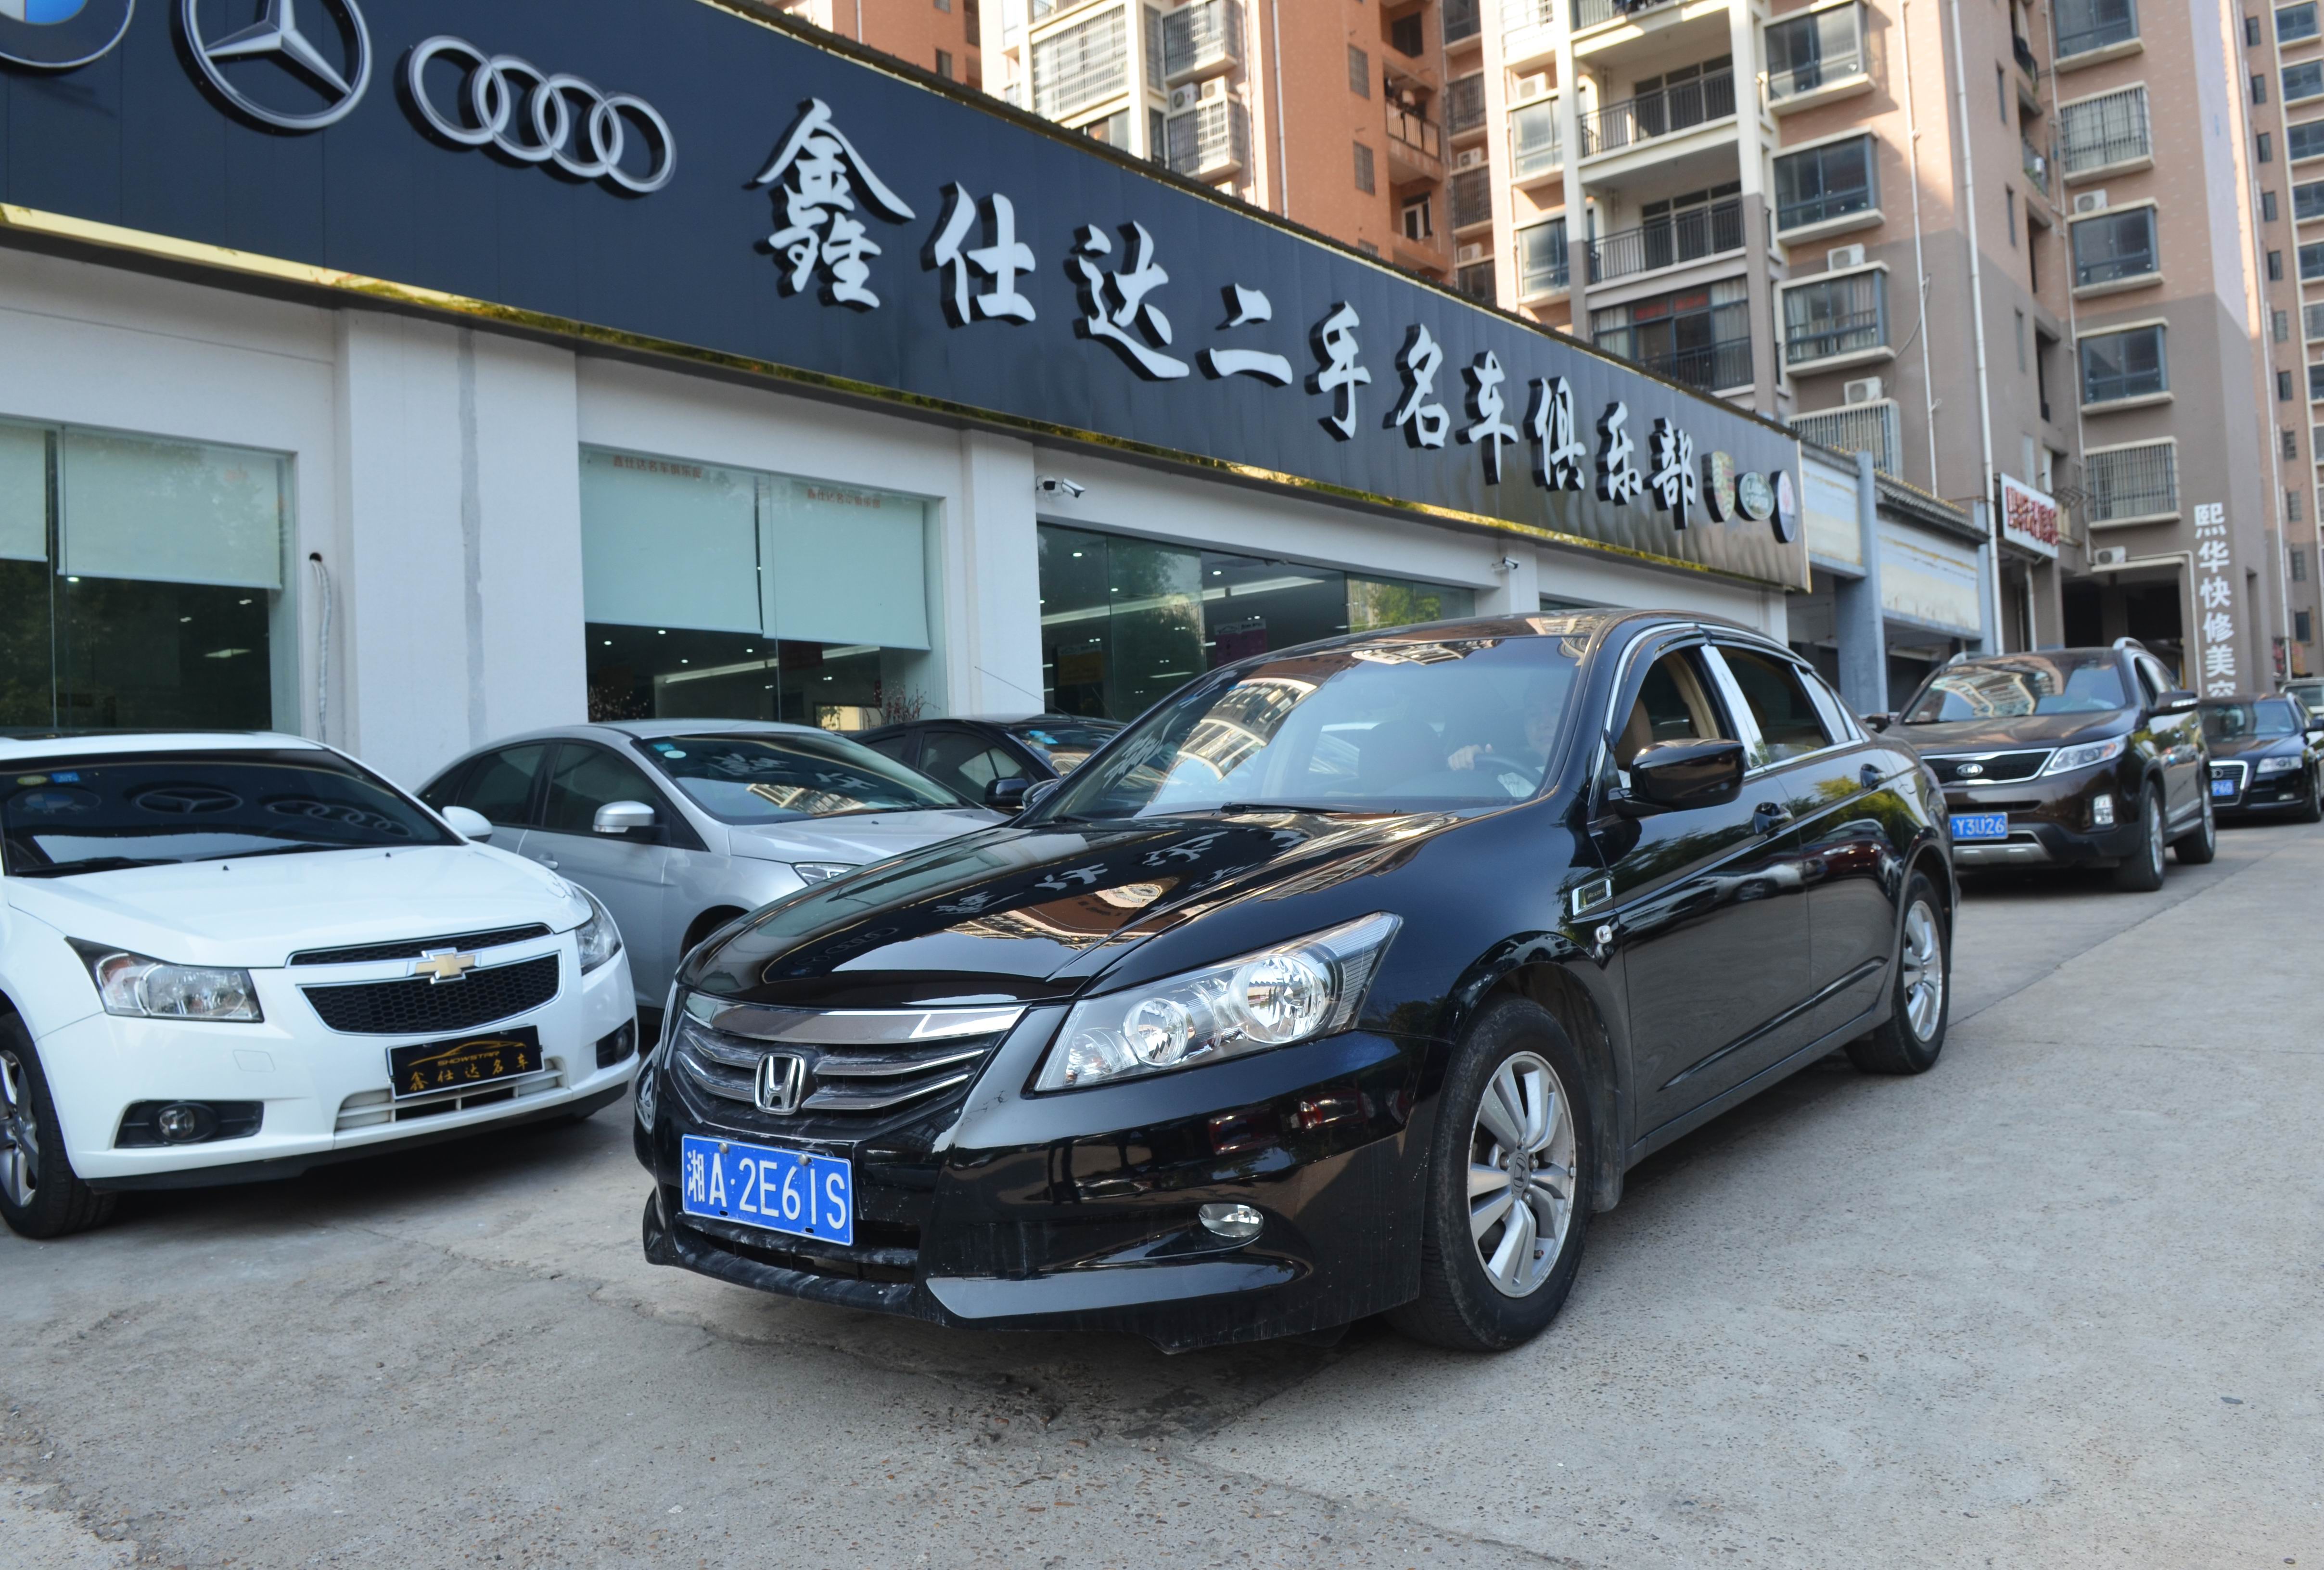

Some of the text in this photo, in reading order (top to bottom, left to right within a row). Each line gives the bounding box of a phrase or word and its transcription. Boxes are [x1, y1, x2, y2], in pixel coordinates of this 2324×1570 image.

[755, 97, 1696, 528] 鑫仕达二手名车俱乐部
